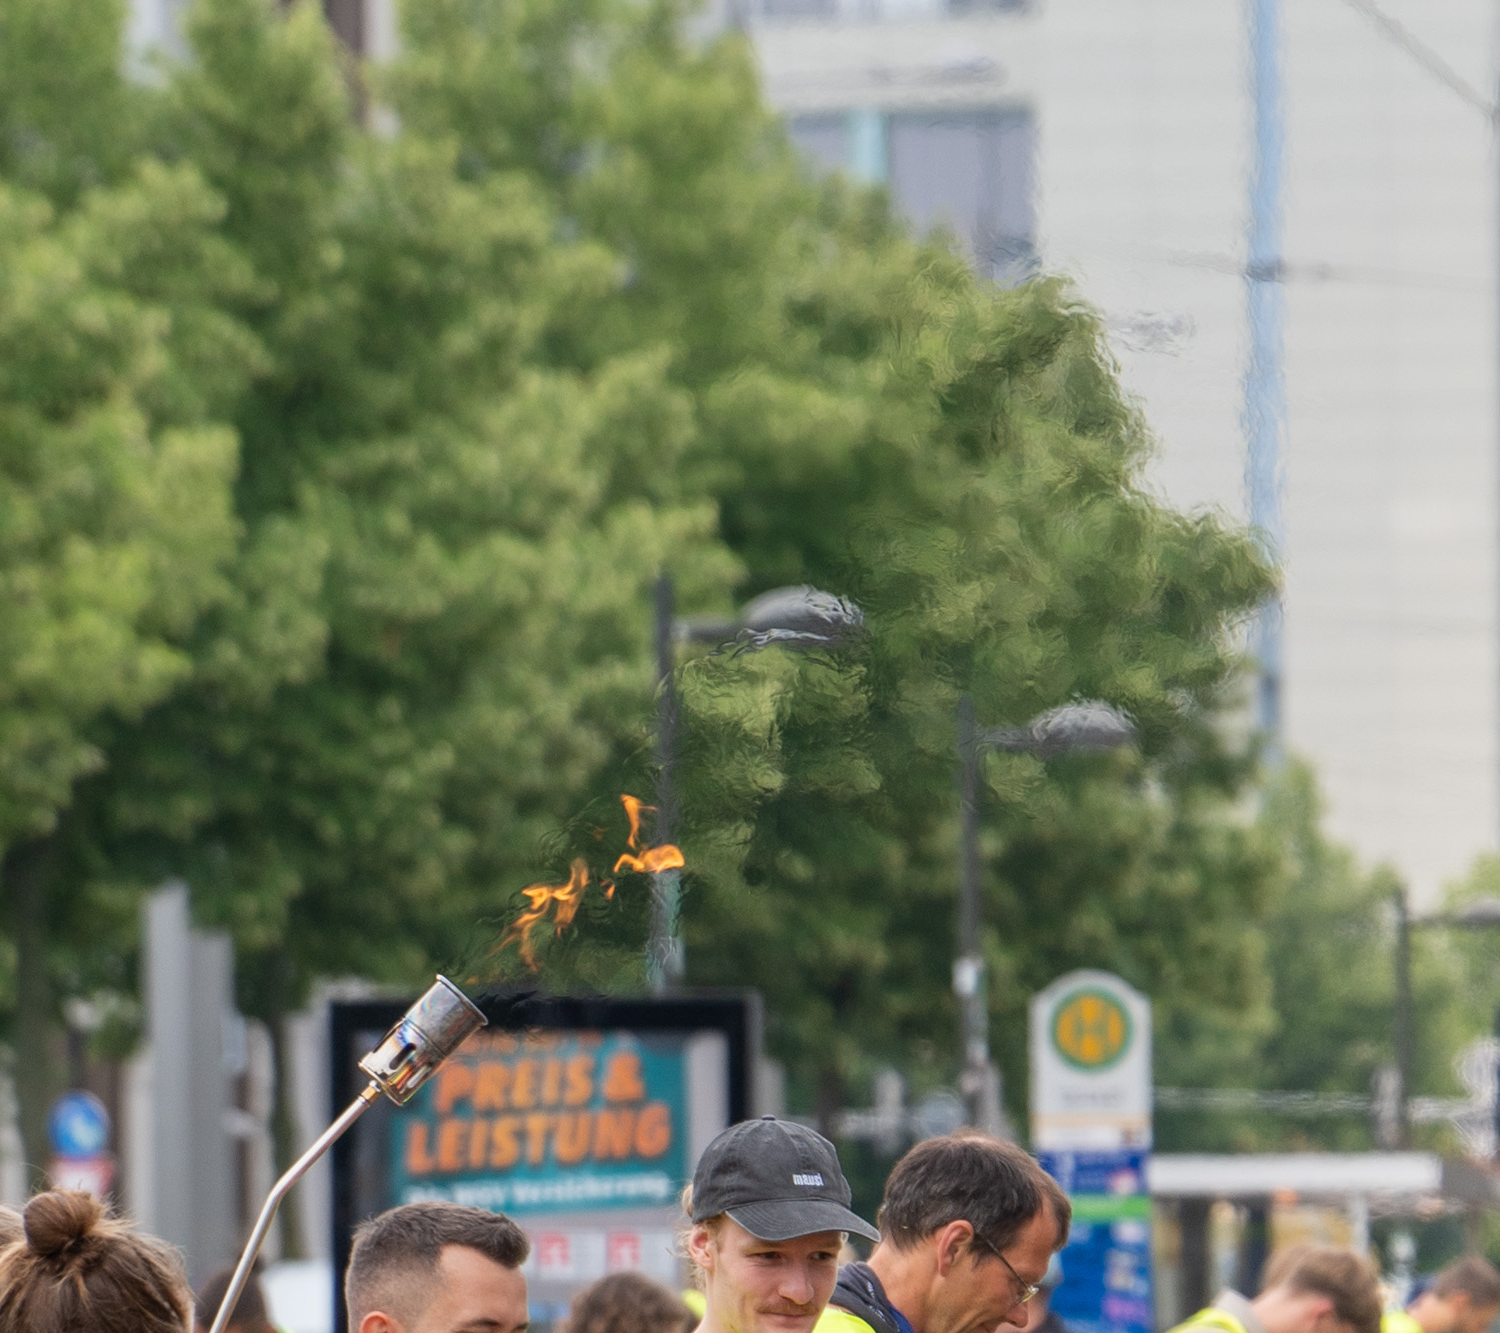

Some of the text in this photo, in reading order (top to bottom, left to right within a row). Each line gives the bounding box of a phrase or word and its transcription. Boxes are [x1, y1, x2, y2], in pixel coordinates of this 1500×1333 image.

[434, 1051, 646, 1113] PREIS &
[406, 1102, 672, 1177] LEISTUNG
